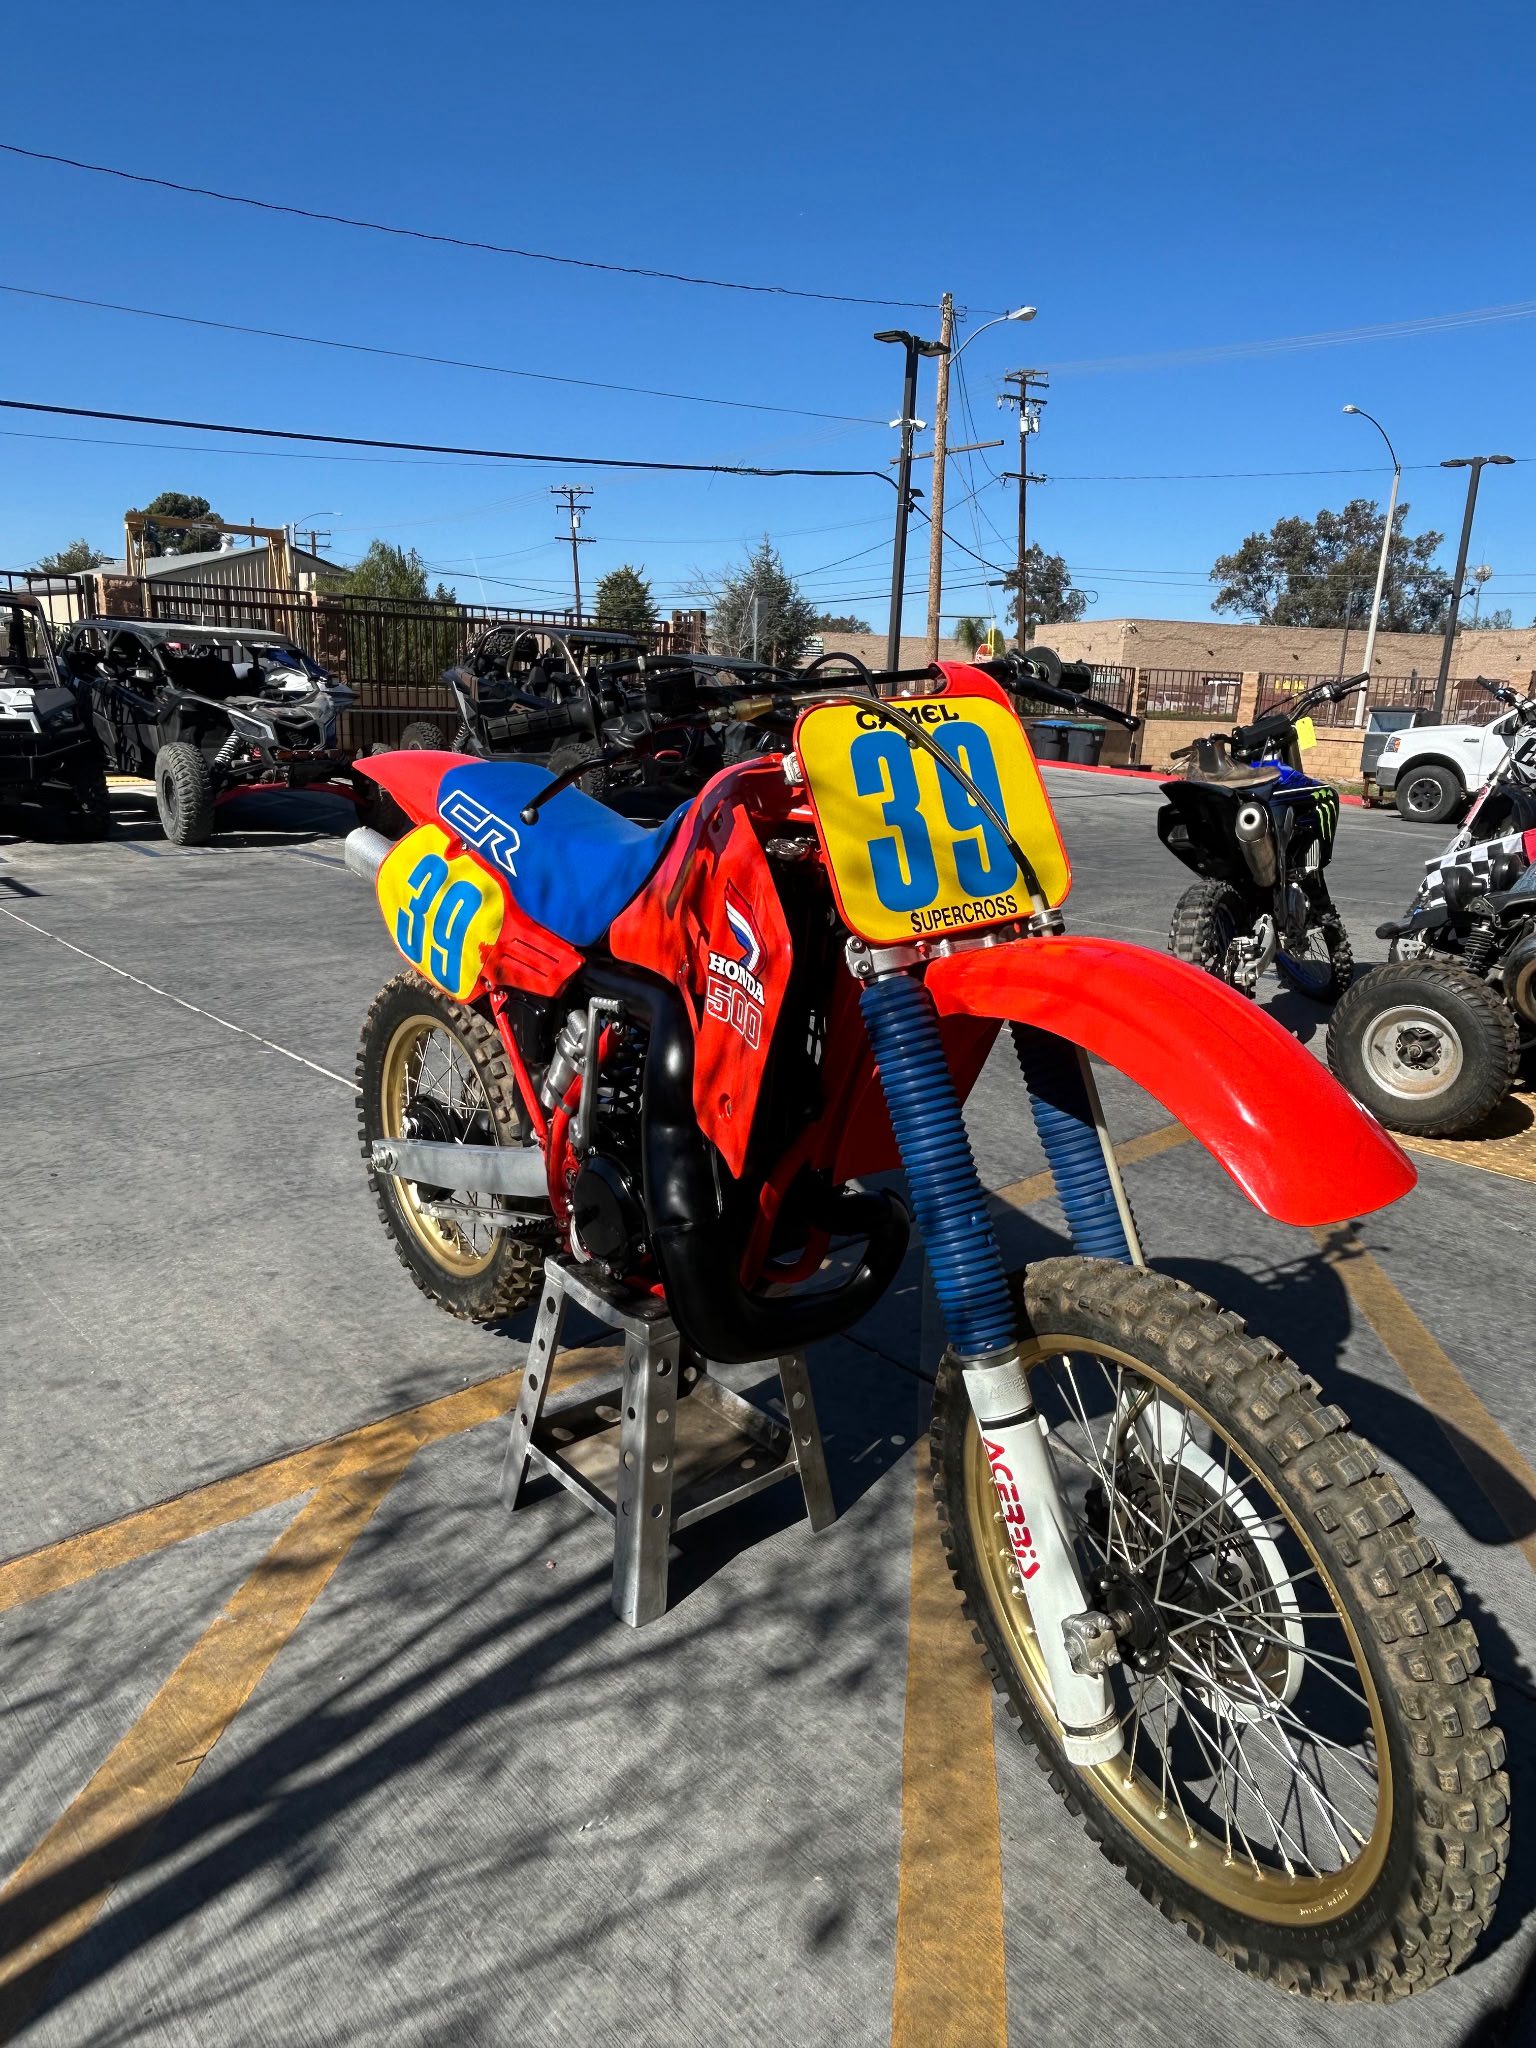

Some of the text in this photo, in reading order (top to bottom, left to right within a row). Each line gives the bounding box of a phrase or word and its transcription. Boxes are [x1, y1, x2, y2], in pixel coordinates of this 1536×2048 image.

[438, 789, 521, 877] CR
[850, 721, 1018, 912] 39
[397, 853, 483, 993] 39
[910, 894, 1018, 933] SUPERCROSS
[706, 975, 762, 1050] 500
[708, 951, 765, 1006] HONDA
